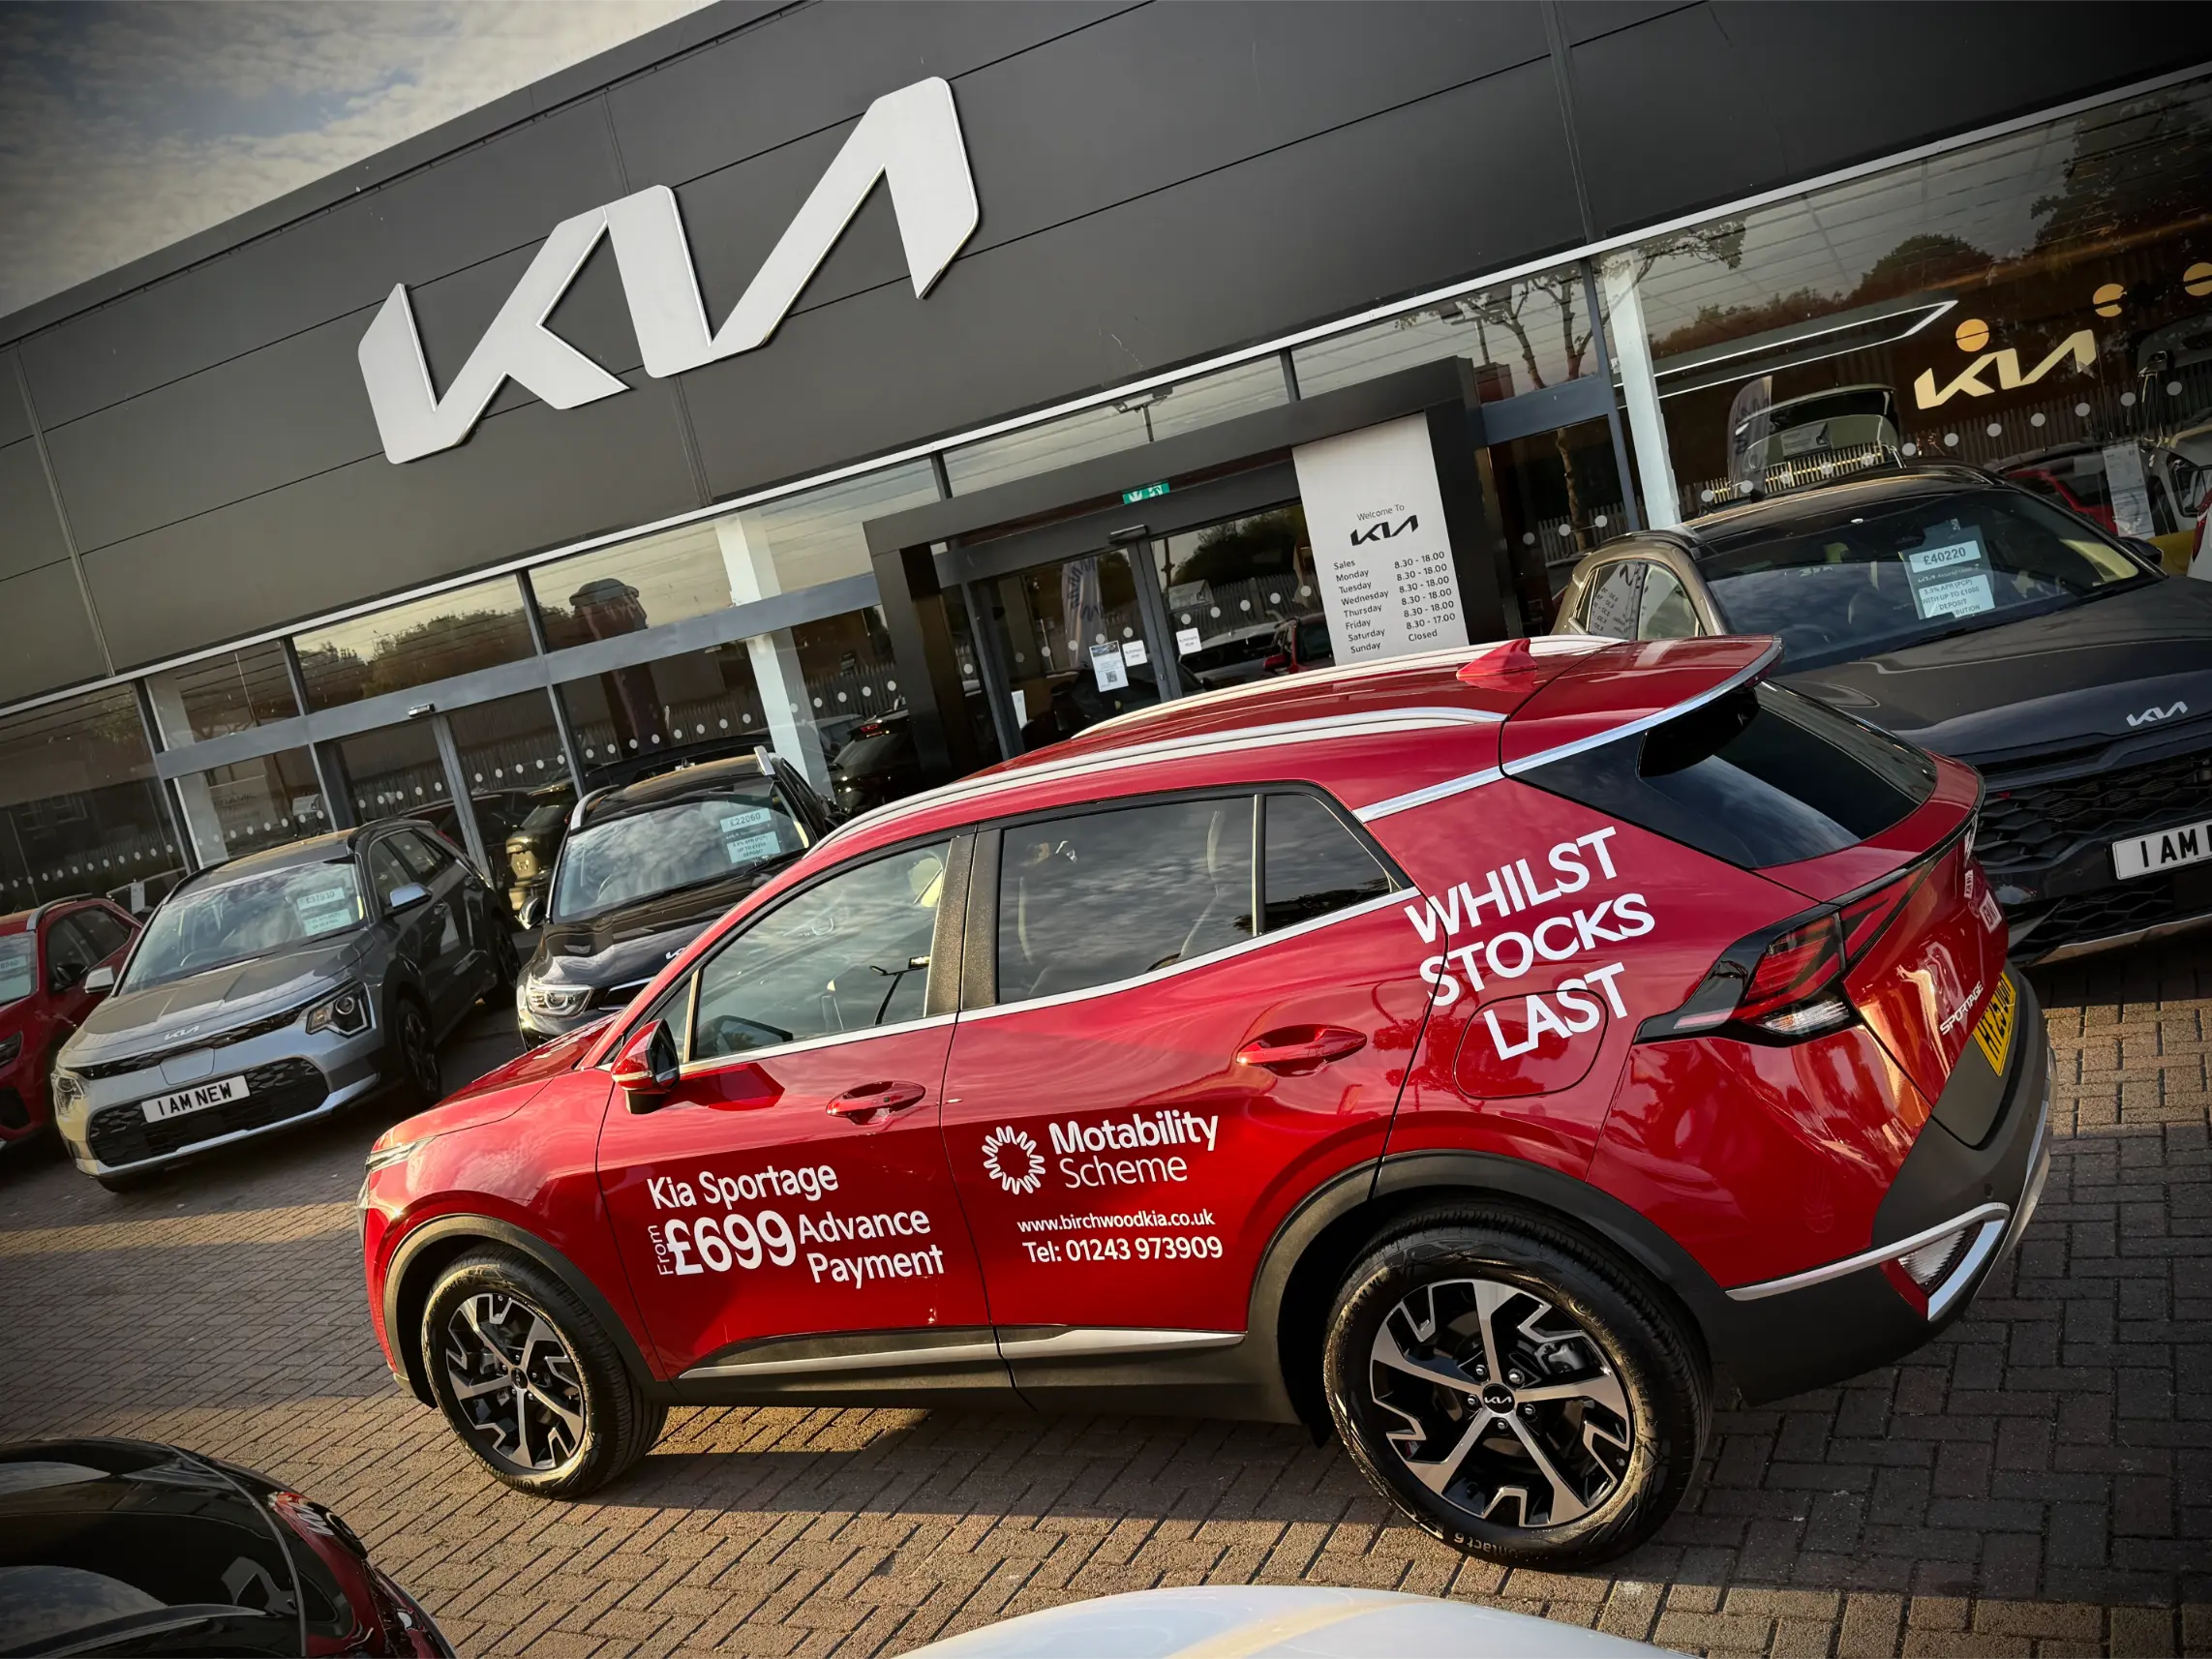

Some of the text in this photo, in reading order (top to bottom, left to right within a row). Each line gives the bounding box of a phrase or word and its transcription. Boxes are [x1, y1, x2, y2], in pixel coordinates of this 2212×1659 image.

[358, 76, 979, 464] KIA
[1914, 329, 2097, 409] KIA
[1356, 504, 1405, 522] Welcome To
[1349, 514, 1419, 547] KIA
[1333, 558, 1356, 570] Sales
[1336, 568, 1369, 583] Monday
[1394, 558, 1413, 569] 8.30
[1421, 551, 1445, 564] 18.00
[1924, 547, 1966, 565] £40220
[1339, 581, 1372, 594] Tuesday
[1396, 570, 1415, 582] 8.30
[1423, 563, 1447, 576] 18.00
[1341, 589, 1389, 607] Wednesday
[1399, 582, 1418, 593] 8.30
[1425, 575, 1450, 588] 18.00
[1343, 603, 1382, 618] Thursday
[1401, 594, 1420, 606] 8.30
[1428, 588, 1452, 600] 18.00
[1346, 618, 1371, 631] Friday
[1404, 606, 1423, 618] 8.30
[1430, 600, 1454, 613] 18.00
[1939, 598, 1967, 611] DEPOSIT
[1348, 628, 1385, 643] Saturday
[1406, 618, 1425, 630] 8.30
[1433, 613, 1456, 625] 17.00
[1350, 629, 1438, 654] Sunday Closed
[2126, 701, 2188, 727] KIA
[2140, 840, 2149, 868] I
[2161, 829, 2198, 864] AM
[1404, 826, 1617, 944] WHILST
[1419, 892, 1655, 1007] STOCKS
[1483, 961, 1628, 1061] LAST
[1939, 980, 1985, 1036] SPORTAGE
[158, 1082, 232, 1116] I AM NEW
[1048, 1110, 1219, 1155] Motability
[647, 1164, 839, 1211] Kia Sportage
[1059, 1156, 1188, 1189] Scheme
[799, 1210, 931, 1245] Advance
[1016, 1208, 1216, 1233] www.birchwoodkia.co.uk
[648, 1224, 674, 1276] From
[664, 1210, 797, 1276] £699
[1022, 1235, 1223, 1263] Tel: 01243 973909
[807, 1244, 945, 1289] Payment
[1484, 1396, 1512, 1404] KIA
